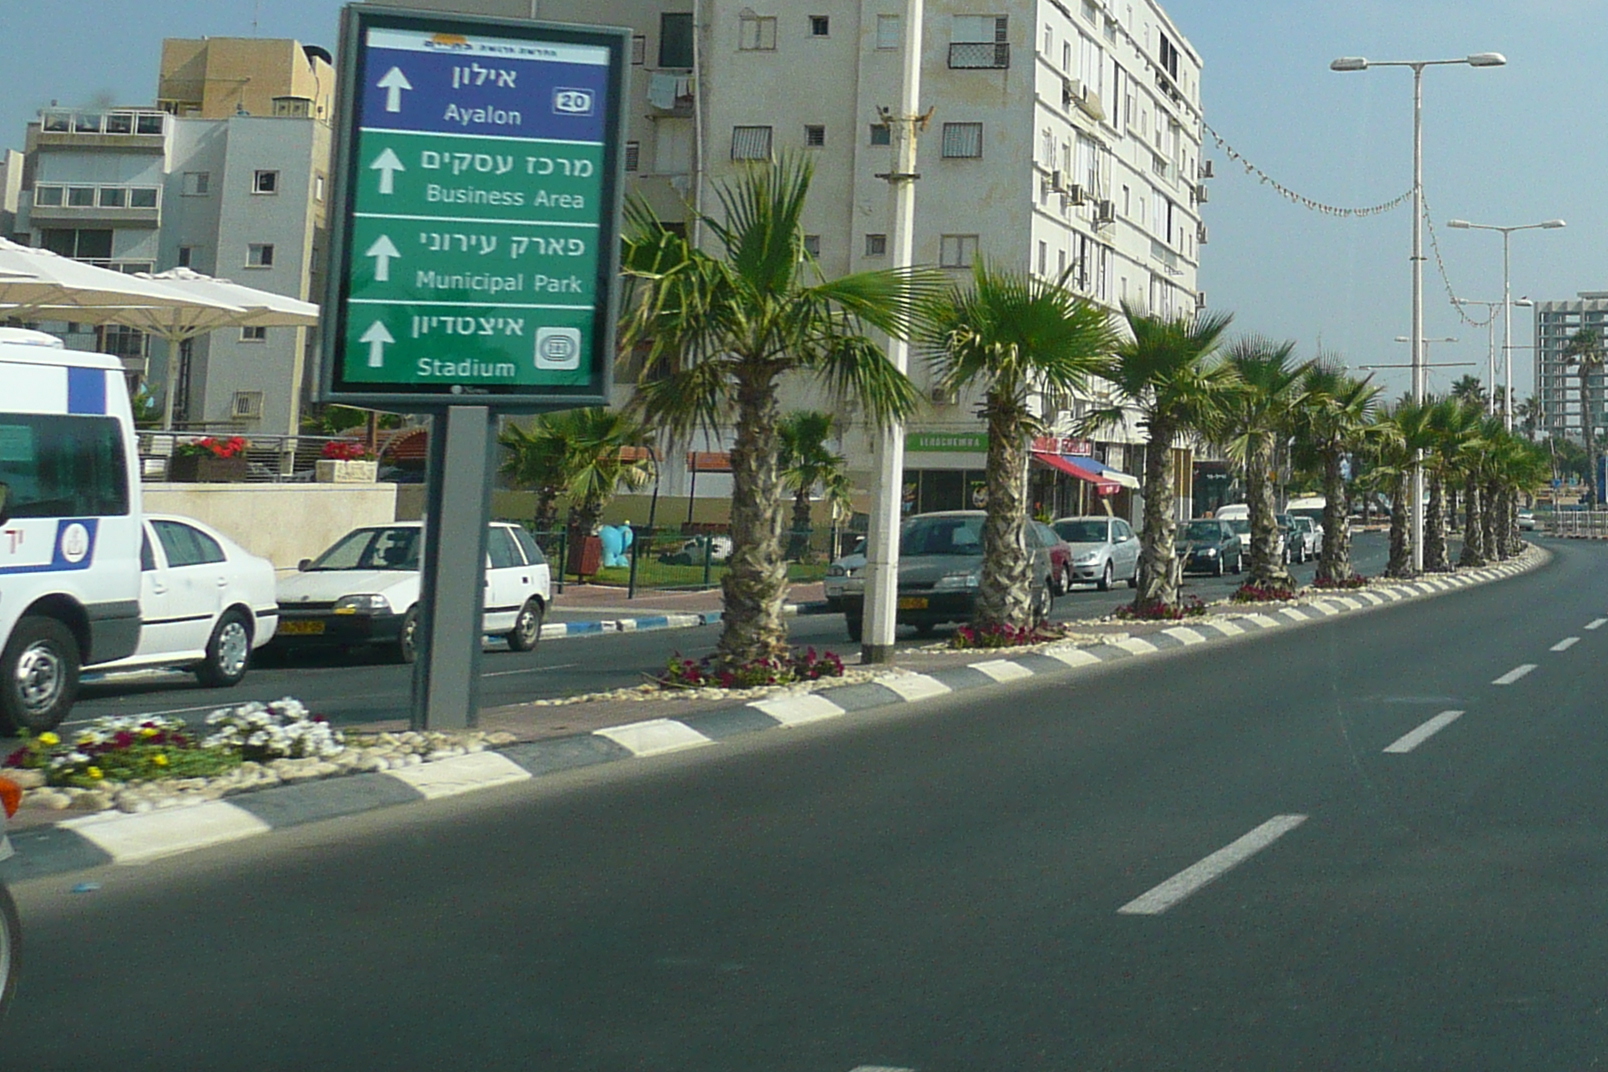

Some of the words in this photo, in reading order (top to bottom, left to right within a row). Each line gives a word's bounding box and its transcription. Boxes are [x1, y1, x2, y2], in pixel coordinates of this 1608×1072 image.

[451, 63, 518, 89] אילון
[560, 93, 585, 109] 20
[443, 103, 522, 126] Ayalon
[421, 150, 514, 176] עסקים
[526, 153, 594, 178] מרכז
[426, 184, 525, 207] Business
[534, 190, 585, 209] Area
[419, 231, 498, 256] עירוני
[510, 236, 586, 259] פארק
[416, 270, 524, 294] Municipal
[534, 275, 582, 293] Park
[412, 314, 525, 337] איצטדיון
[416, 358, 516, 378] Stadium
